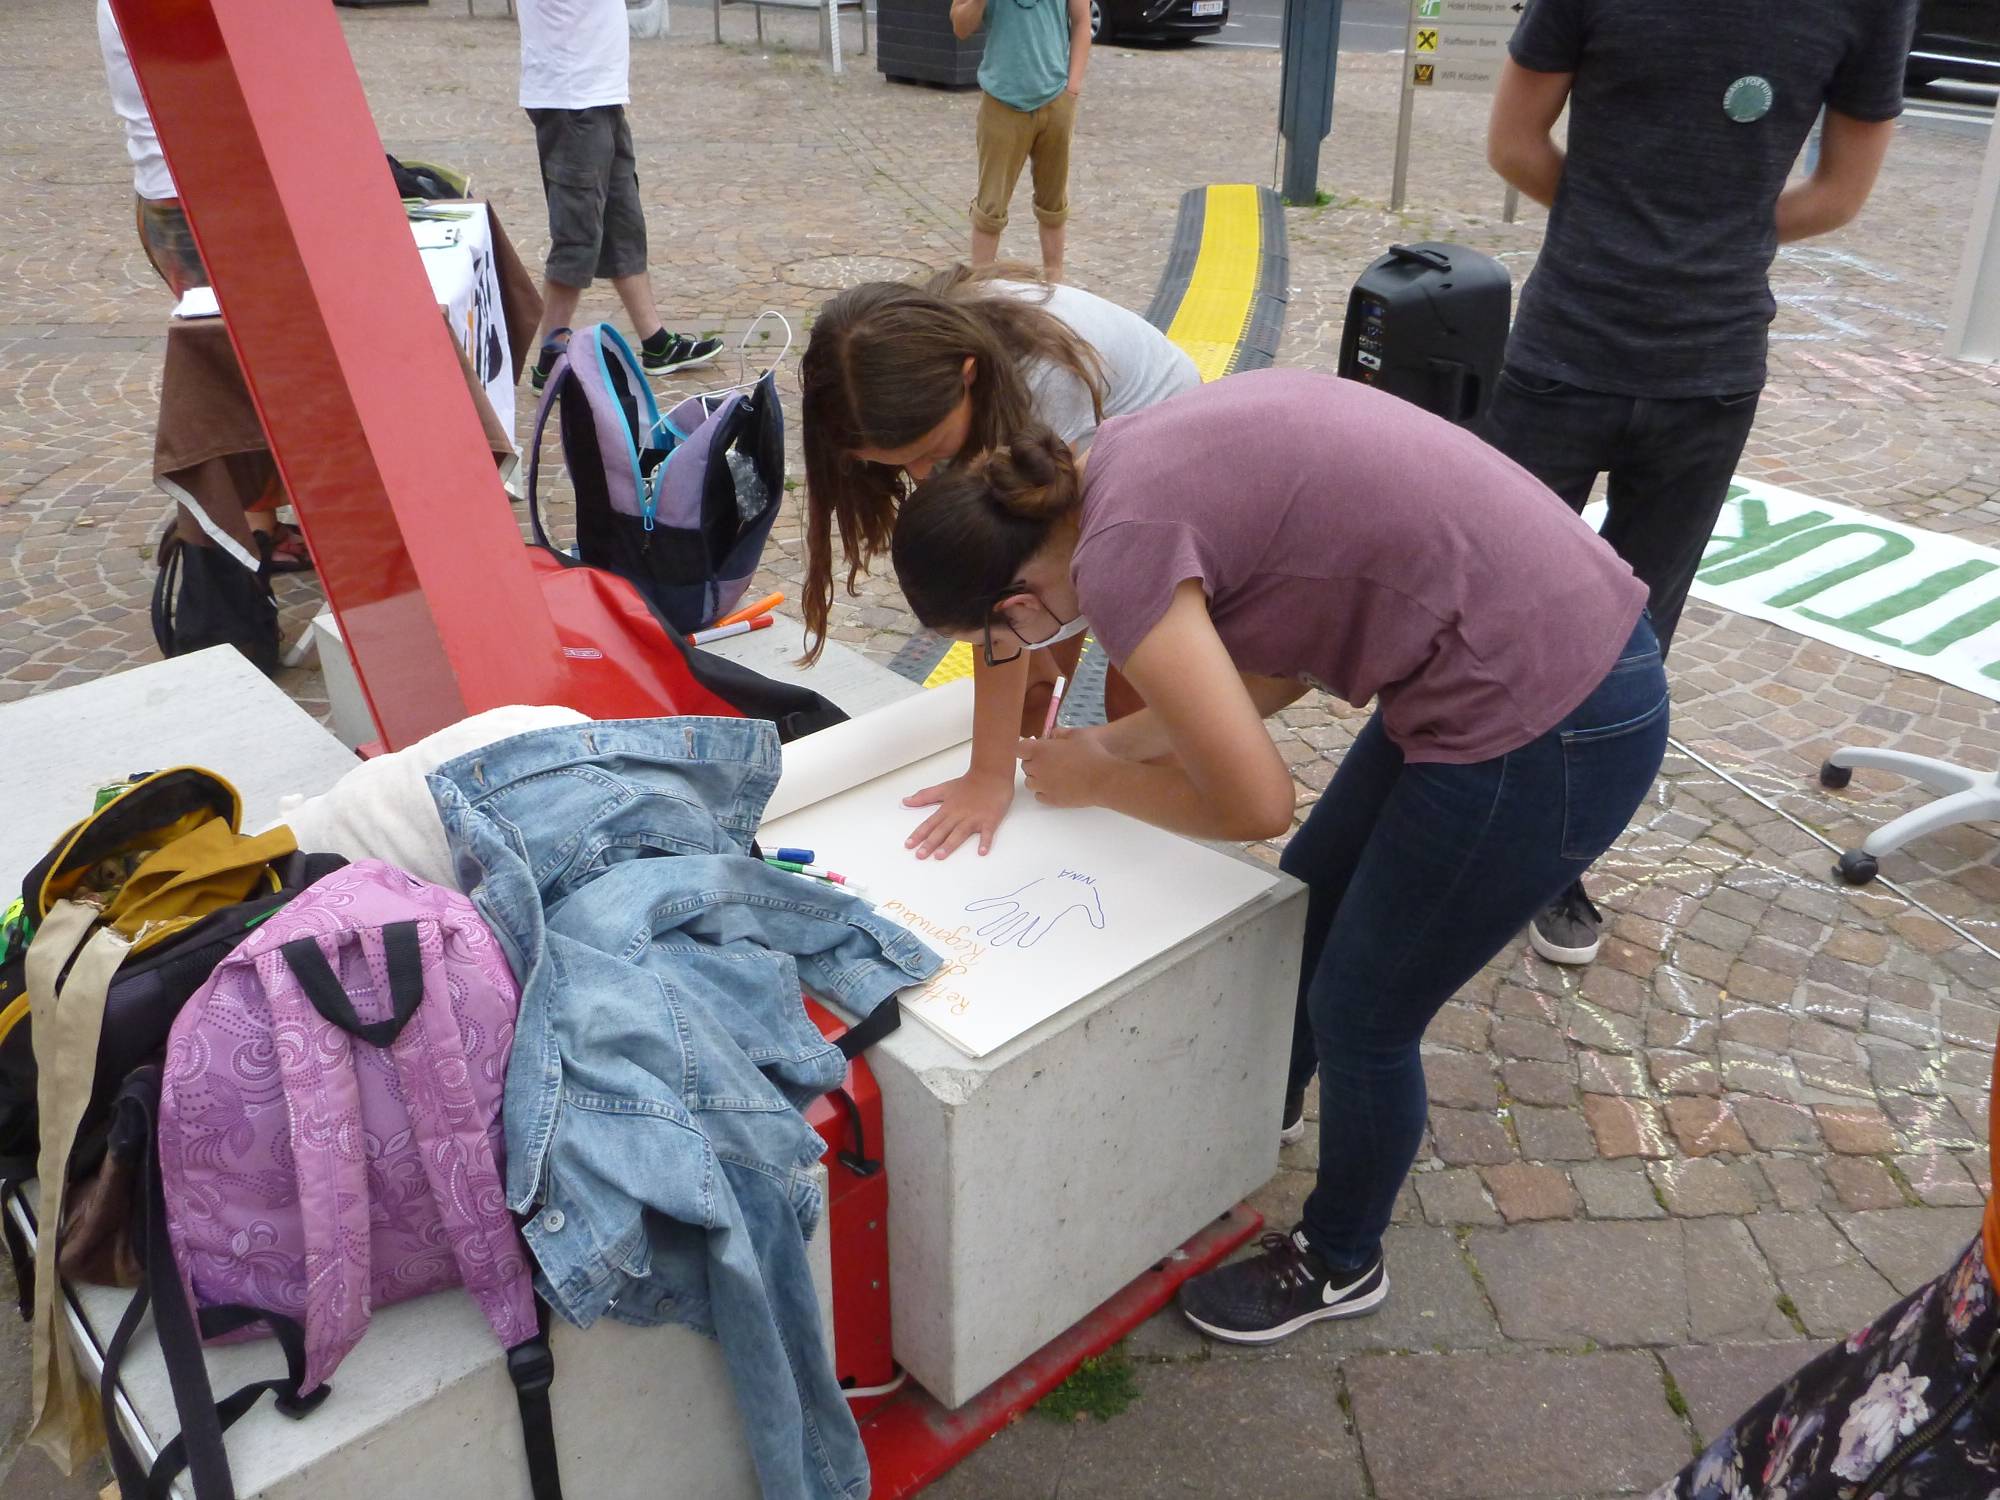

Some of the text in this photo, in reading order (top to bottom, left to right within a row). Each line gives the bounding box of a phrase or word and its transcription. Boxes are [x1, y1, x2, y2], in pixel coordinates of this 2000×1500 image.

[1441, 71, 1490, 81] WR Küchen
[1057, 868, 1097, 885] NINA
